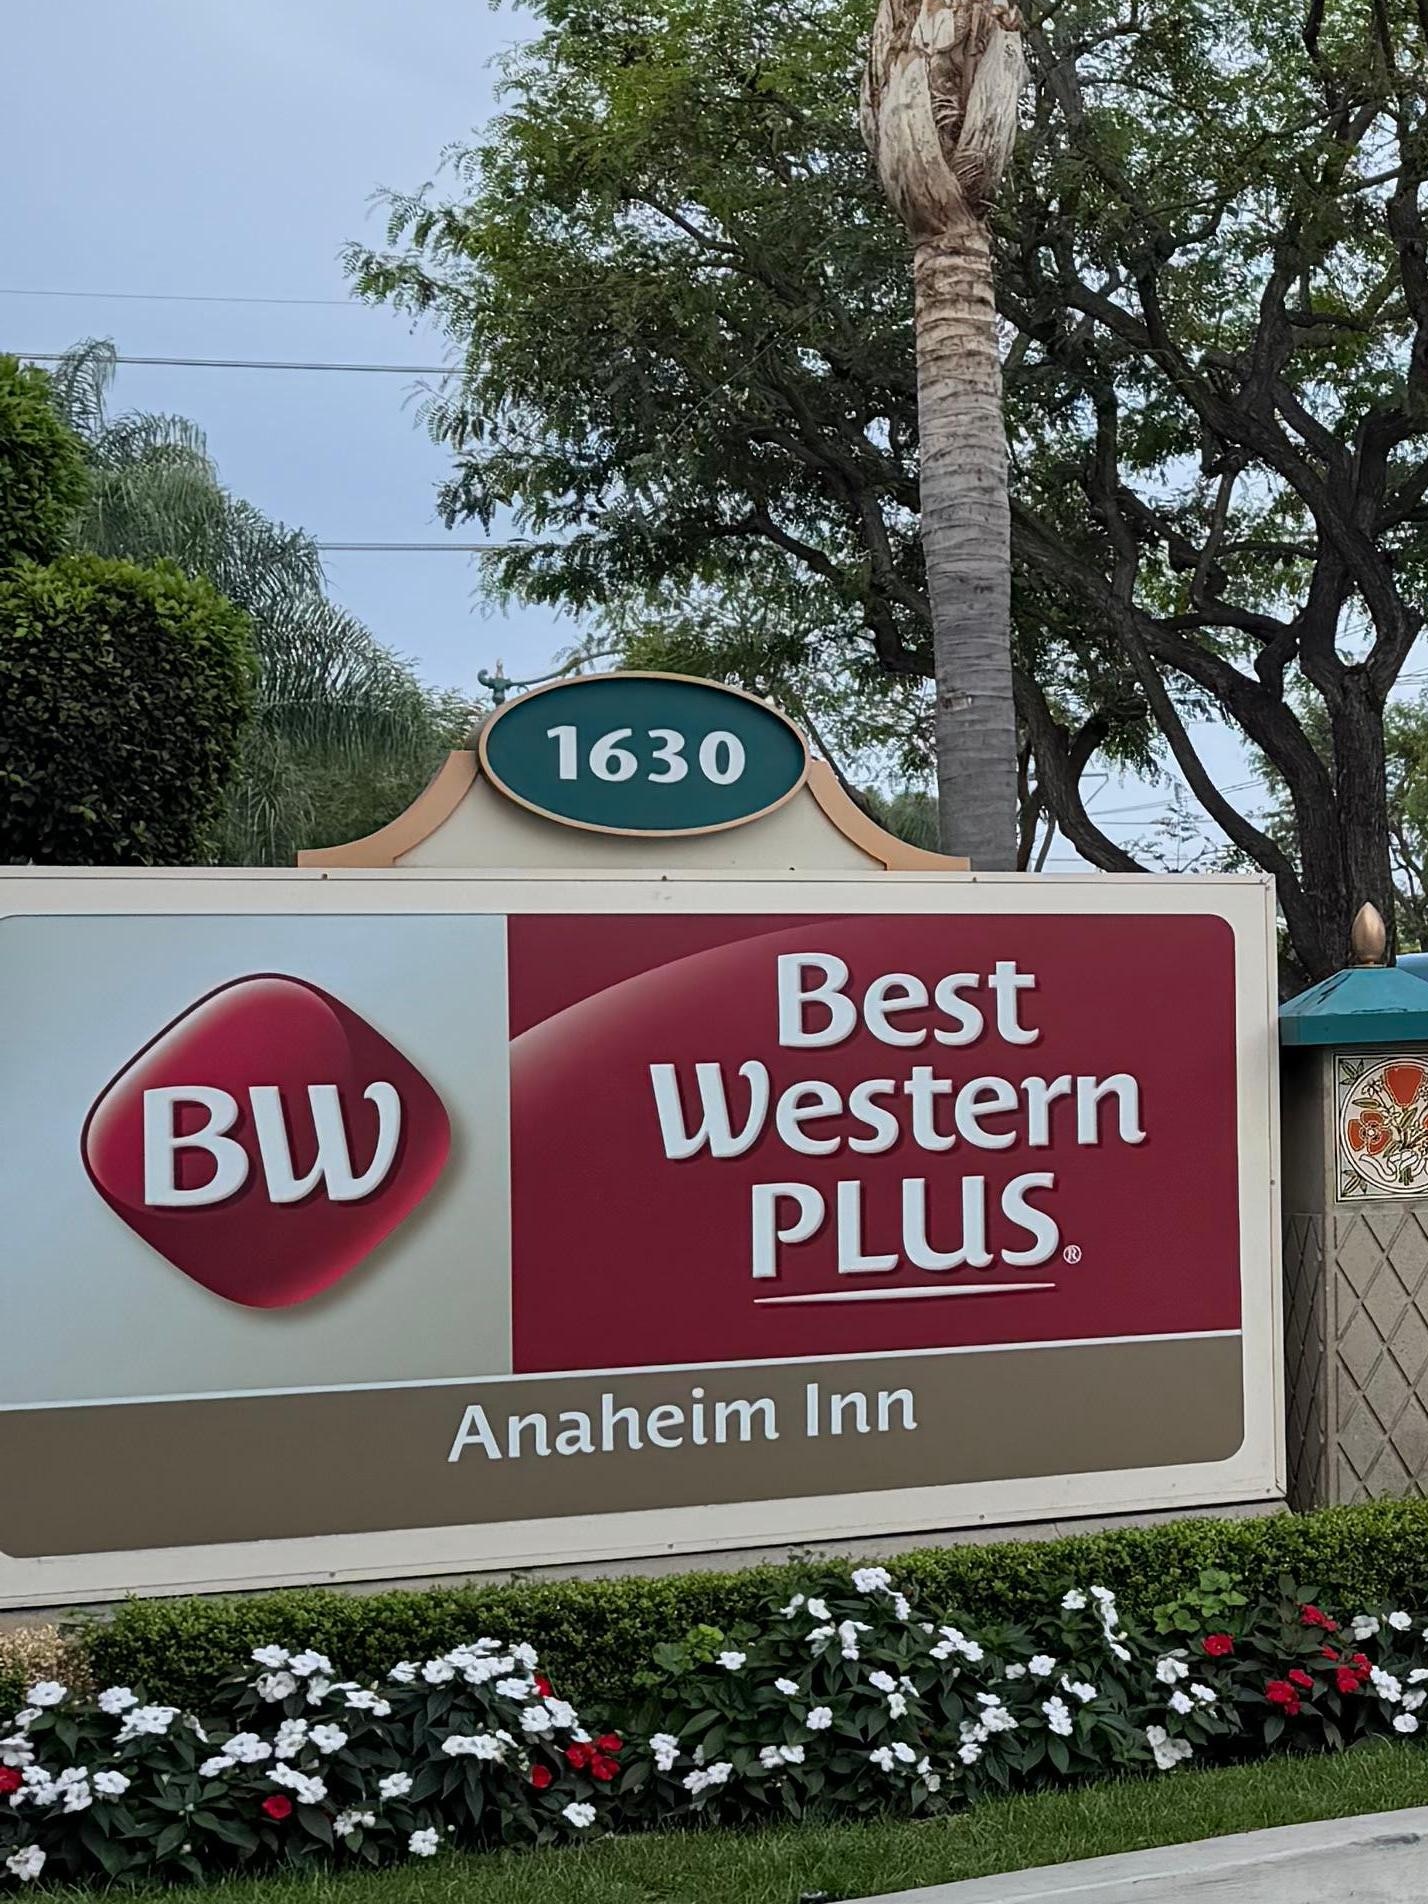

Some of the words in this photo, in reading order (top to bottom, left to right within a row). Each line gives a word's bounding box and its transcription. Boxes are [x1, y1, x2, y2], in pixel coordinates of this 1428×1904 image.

[547, 725, 747, 786] 1630
[778, 953, 1038, 1047] Best
[143, 1083, 401, 1208] BW
[650, 1060, 1146, 1161] Western
[447, 1387, 780, 1463] Anaheim
[806, 1382, 917, 1441] Inn
